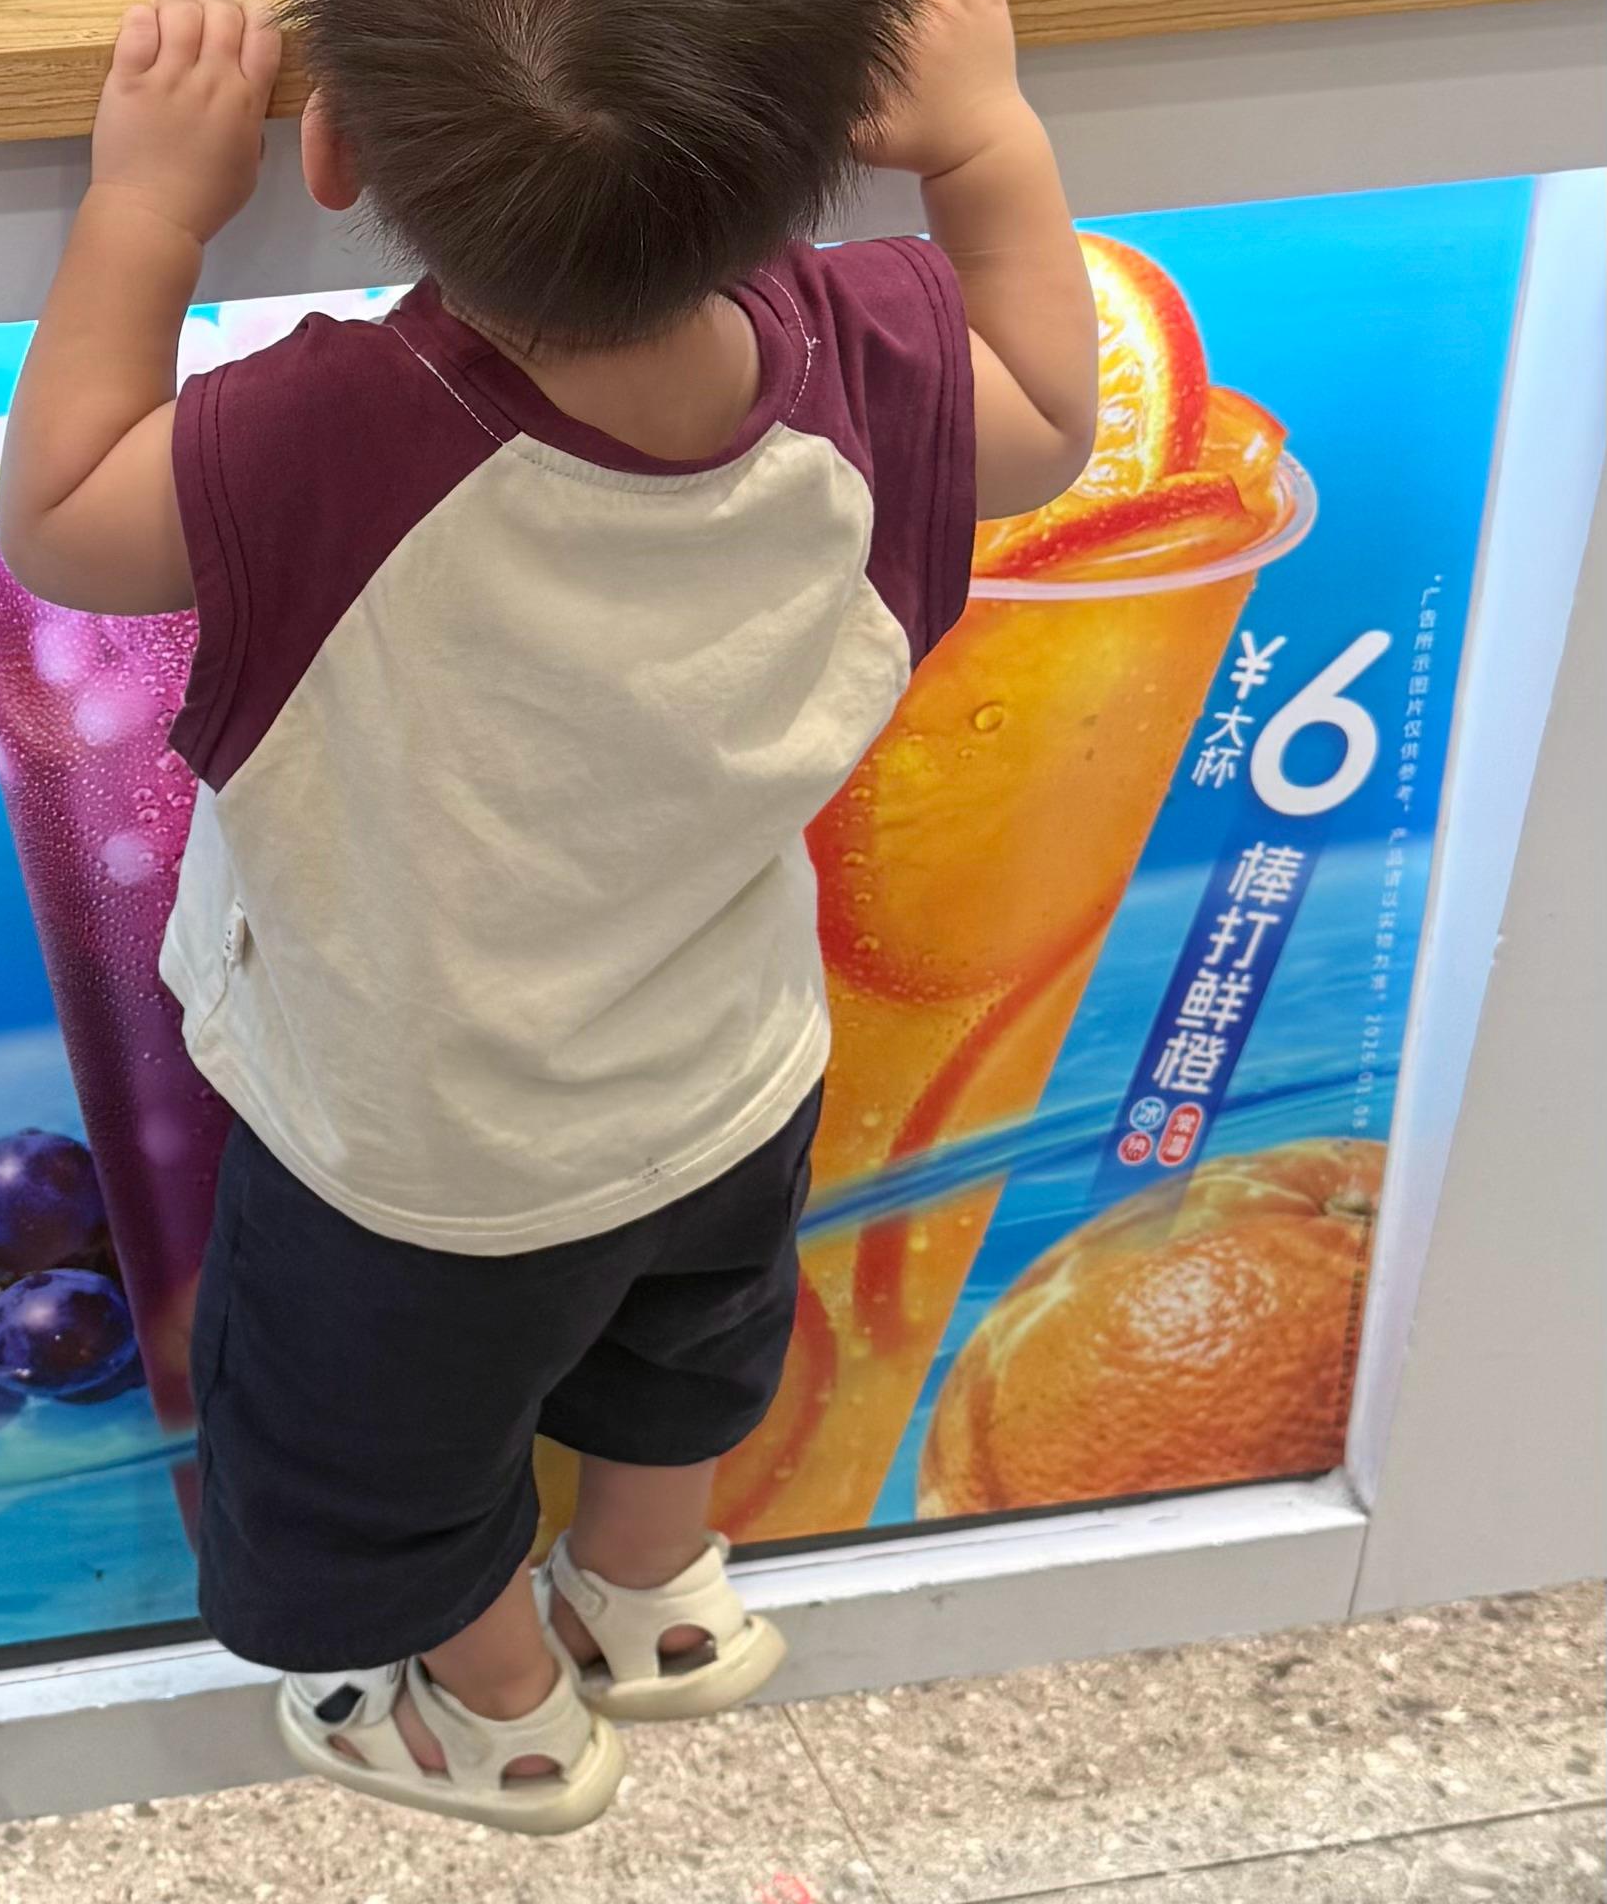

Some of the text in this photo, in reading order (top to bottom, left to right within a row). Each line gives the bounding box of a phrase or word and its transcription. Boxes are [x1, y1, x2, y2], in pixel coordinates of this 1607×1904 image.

[1191, 706, 1254, 788] 大杯
[1152, 841, 1305, 1095] 棒打鲜橙
